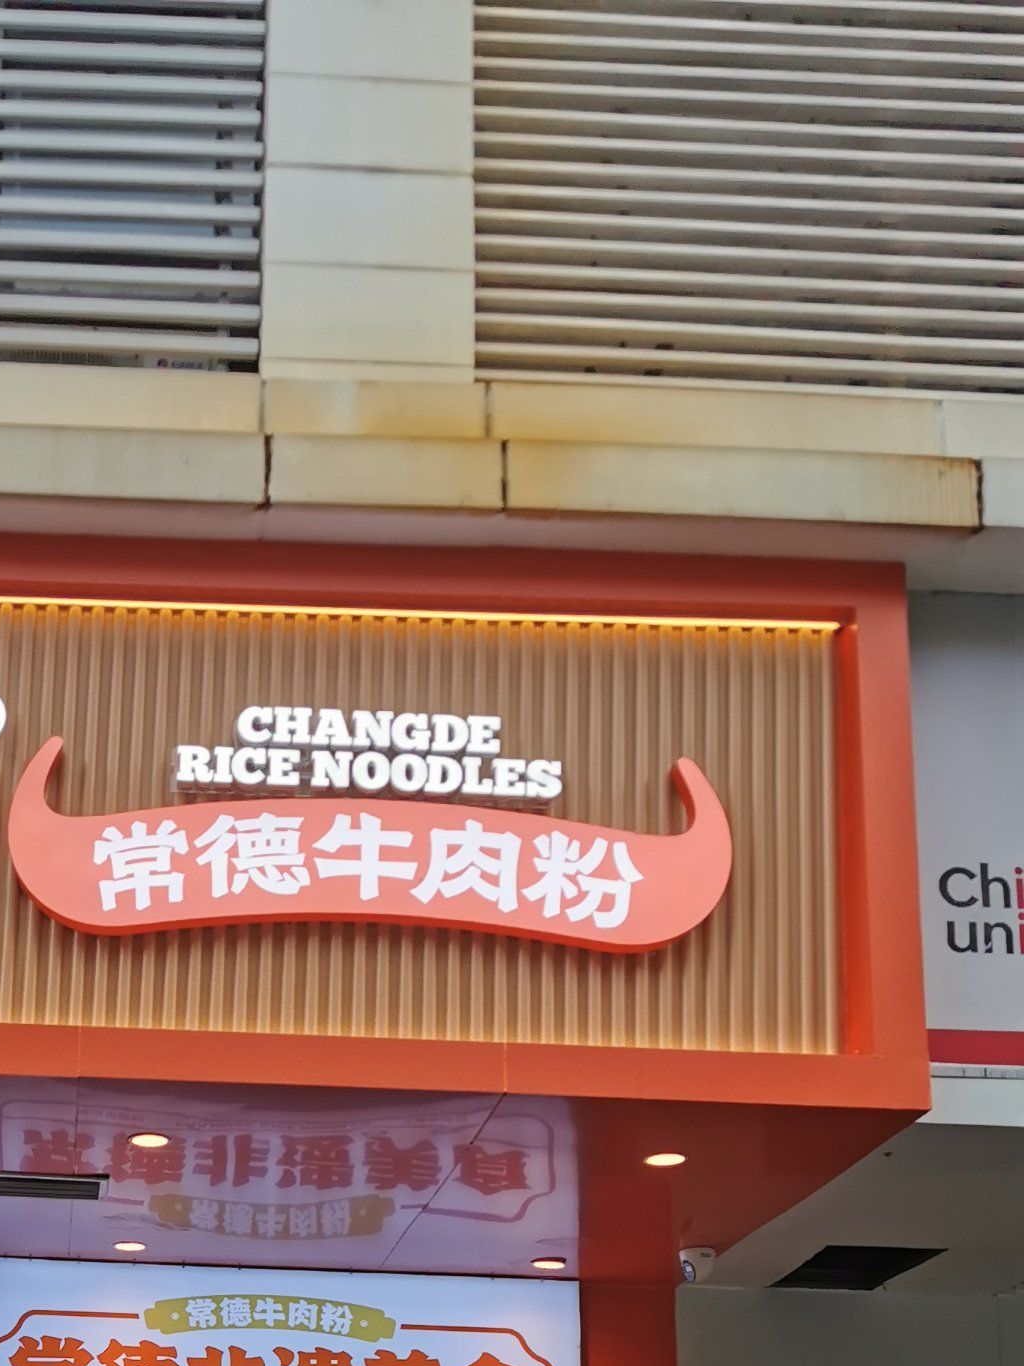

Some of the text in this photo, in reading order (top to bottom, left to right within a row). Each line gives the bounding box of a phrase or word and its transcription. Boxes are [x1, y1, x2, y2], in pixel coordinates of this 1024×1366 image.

[237, 705, 502, 755] CHANGDE
[176, 744, 563, 800] RICE NOODLES
[92, 812, 644, 931] 常德牛肉粉
[939, 863, 1024, 909] Chi
[946, 912, 1024, 954] uni
[184, 1296, 354, 1335] 常德牛肉粉
